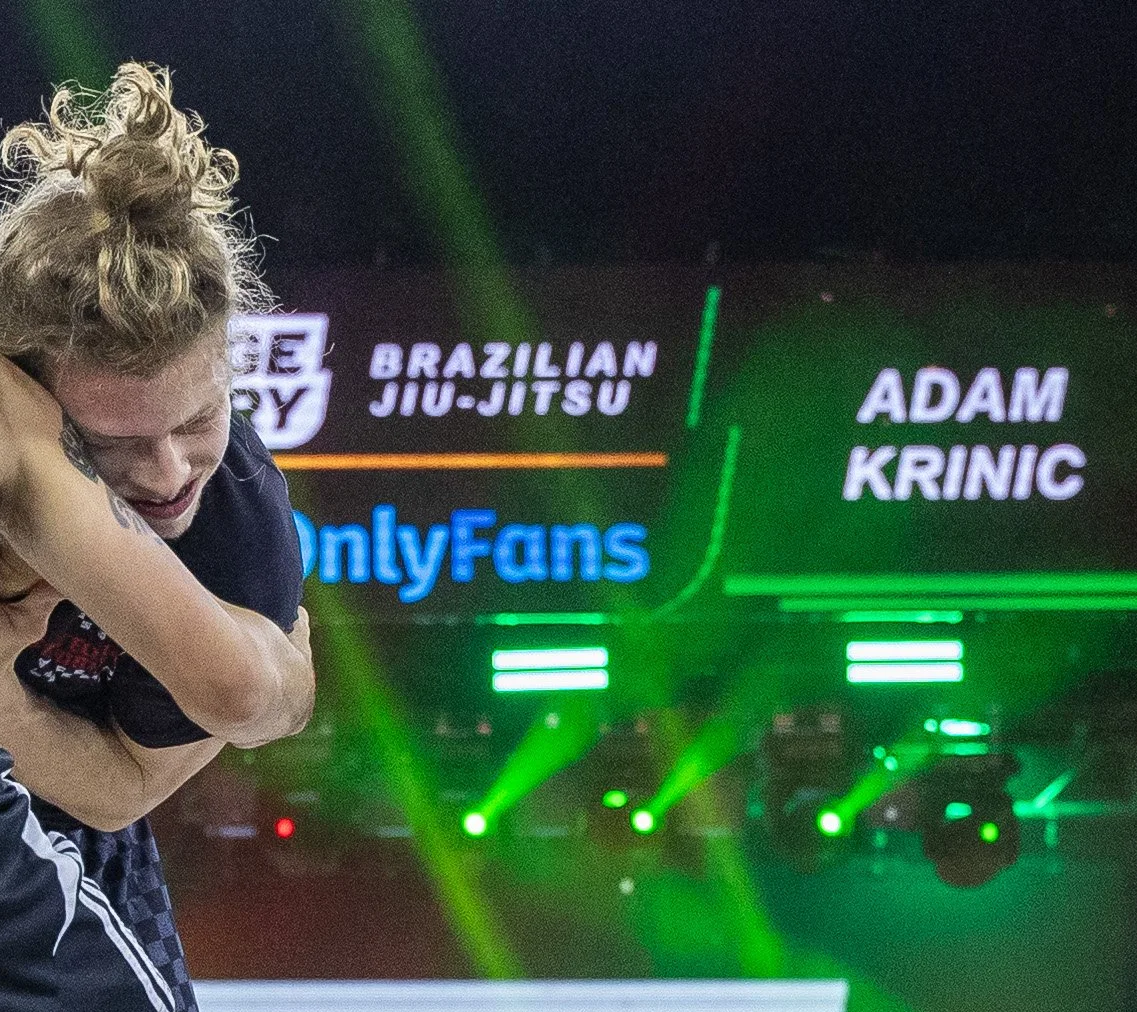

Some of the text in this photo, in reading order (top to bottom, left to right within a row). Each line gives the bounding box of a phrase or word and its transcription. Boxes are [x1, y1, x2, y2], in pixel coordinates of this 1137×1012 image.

[369, 340, 658, 379] BRAZILIAN
[369, 379, 631, 418] JIU-JITSU
[856, 366, 1069, 424] ADAM
[842, 443, 1087, 501] KRINIC
